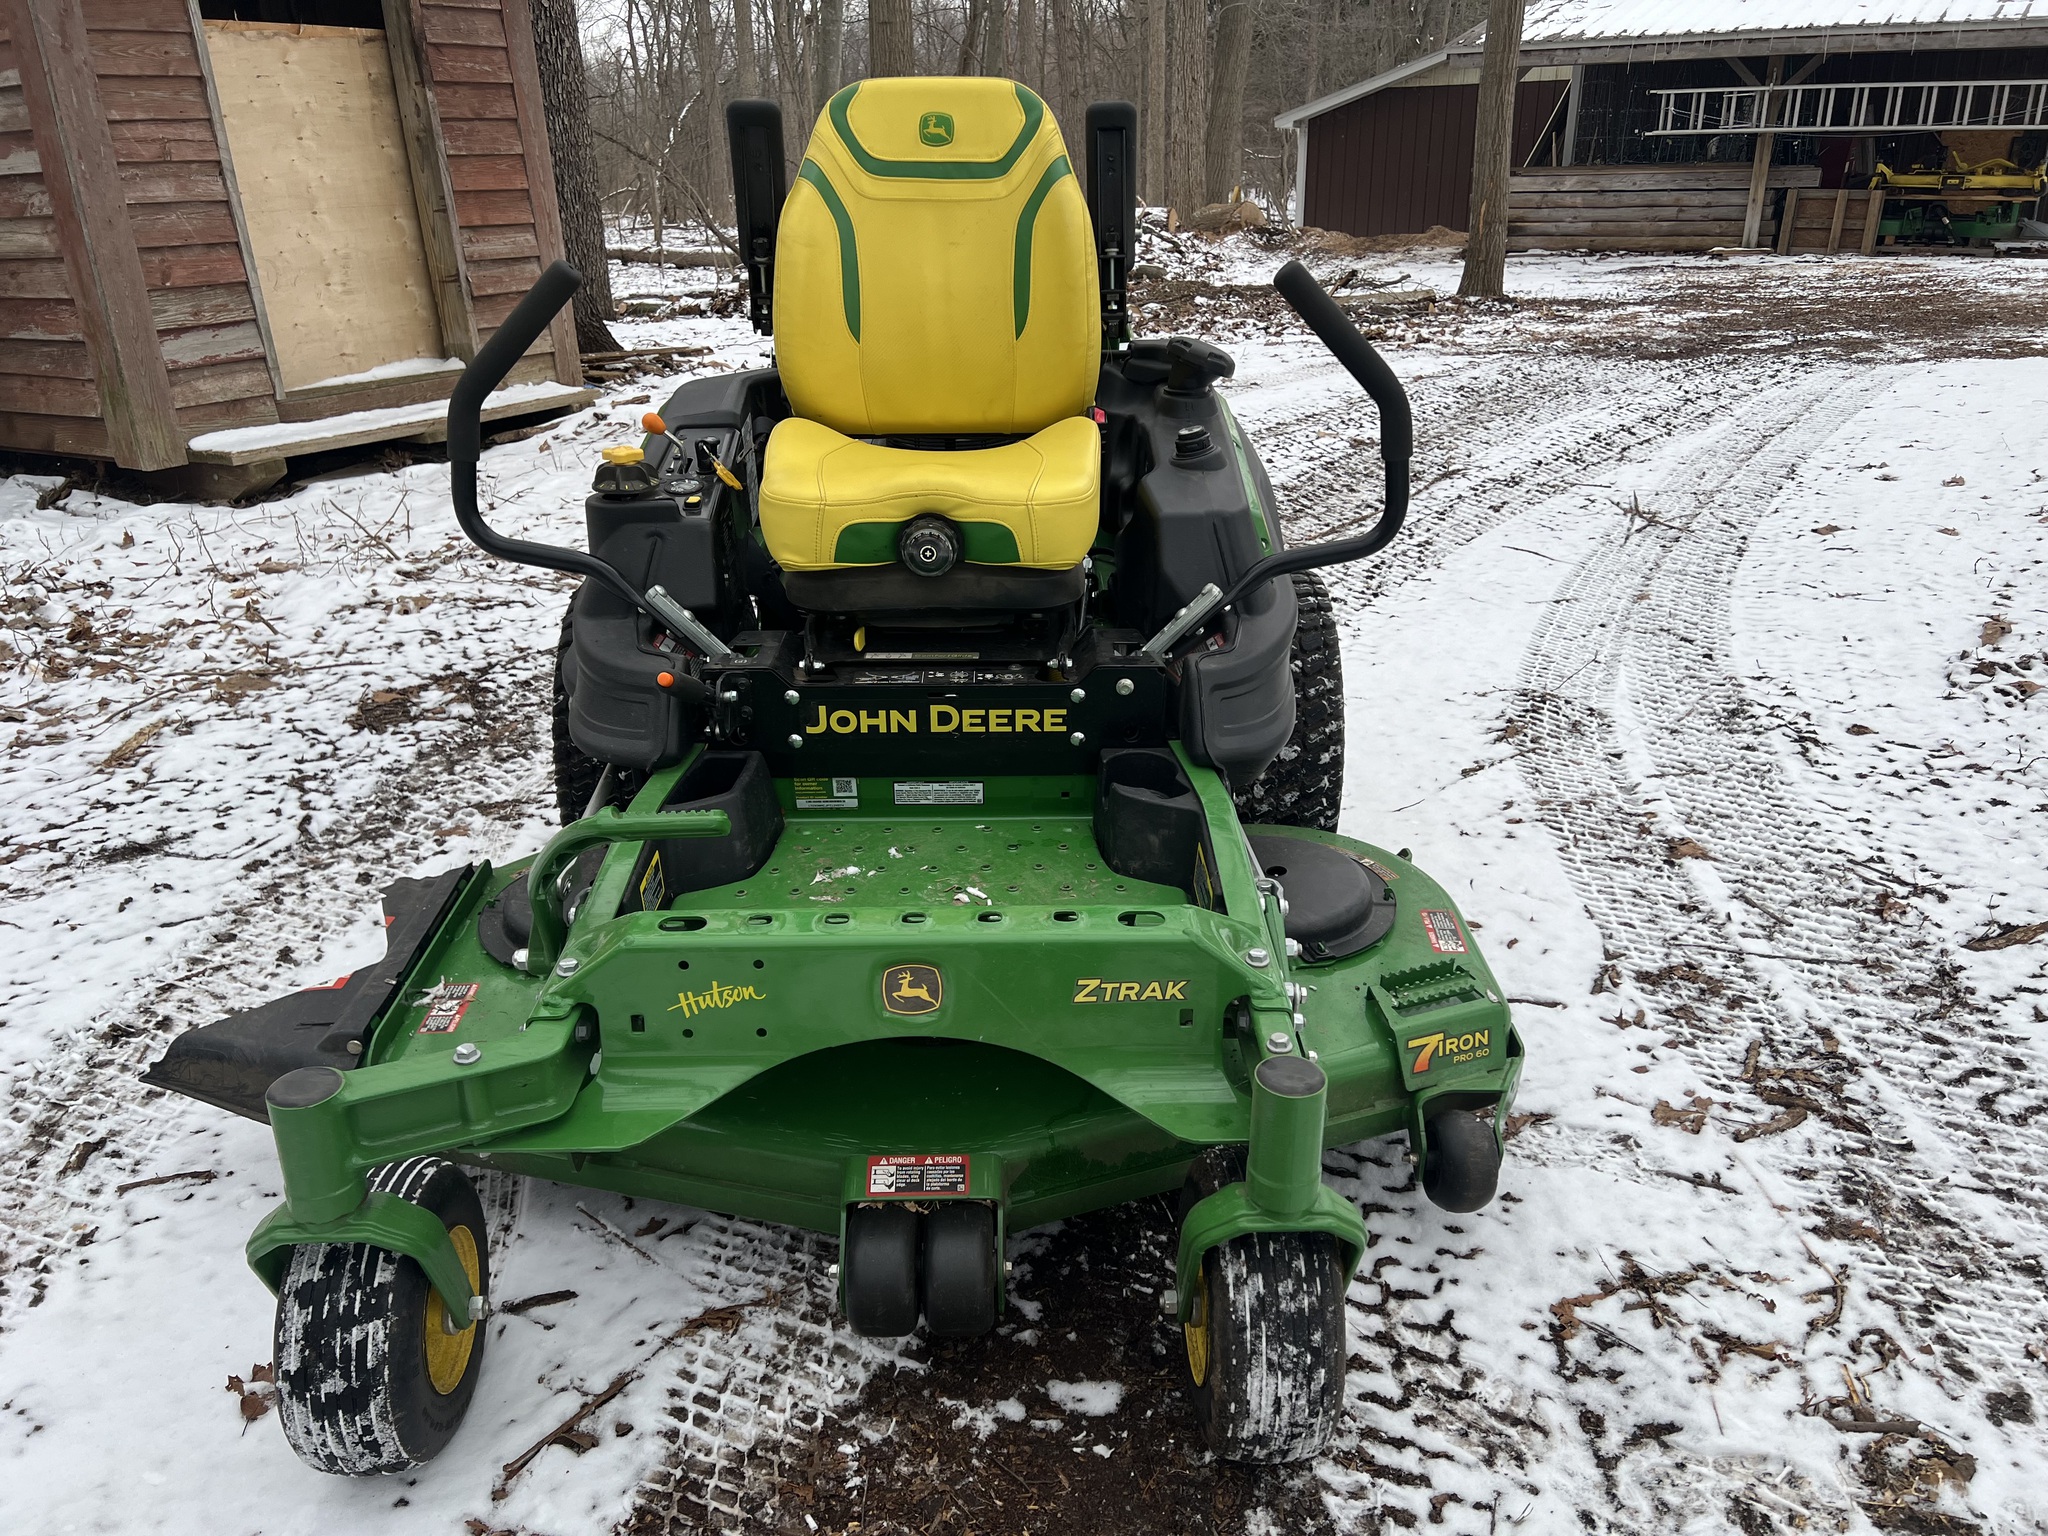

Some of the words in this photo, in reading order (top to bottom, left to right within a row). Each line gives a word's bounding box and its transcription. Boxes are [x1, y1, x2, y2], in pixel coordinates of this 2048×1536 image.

[806, 705, 917, 734] JOHN
[930, 705, 1067, 732] DEERE
[667, 981, 767, 1018] Hutson
[1073, 978, 1189, 1003] ZTRAK
[1454, 1052, 1474, 1064] PRO
[1476, 1048, 1490, 1058] 60
